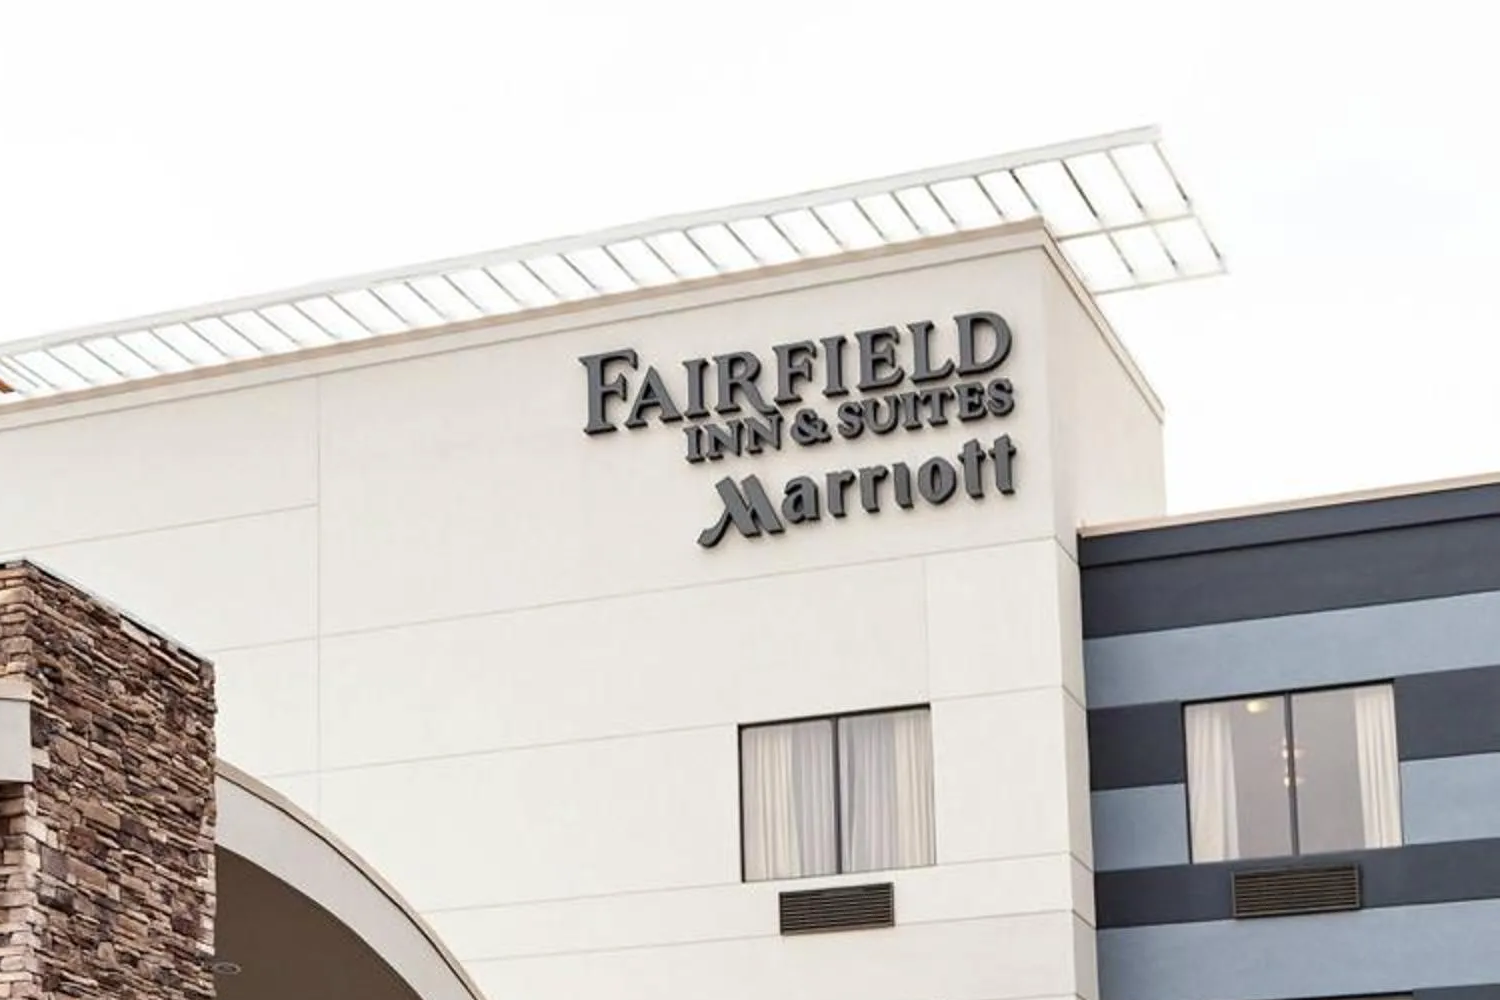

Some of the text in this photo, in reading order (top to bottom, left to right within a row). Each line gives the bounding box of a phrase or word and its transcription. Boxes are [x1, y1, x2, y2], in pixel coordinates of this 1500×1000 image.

[579, 310, 1013, 435] FAIRFIELD
[683, 377, 1015, 463] INN & SUITES
[697, 433, 1017, 549] Marriott
